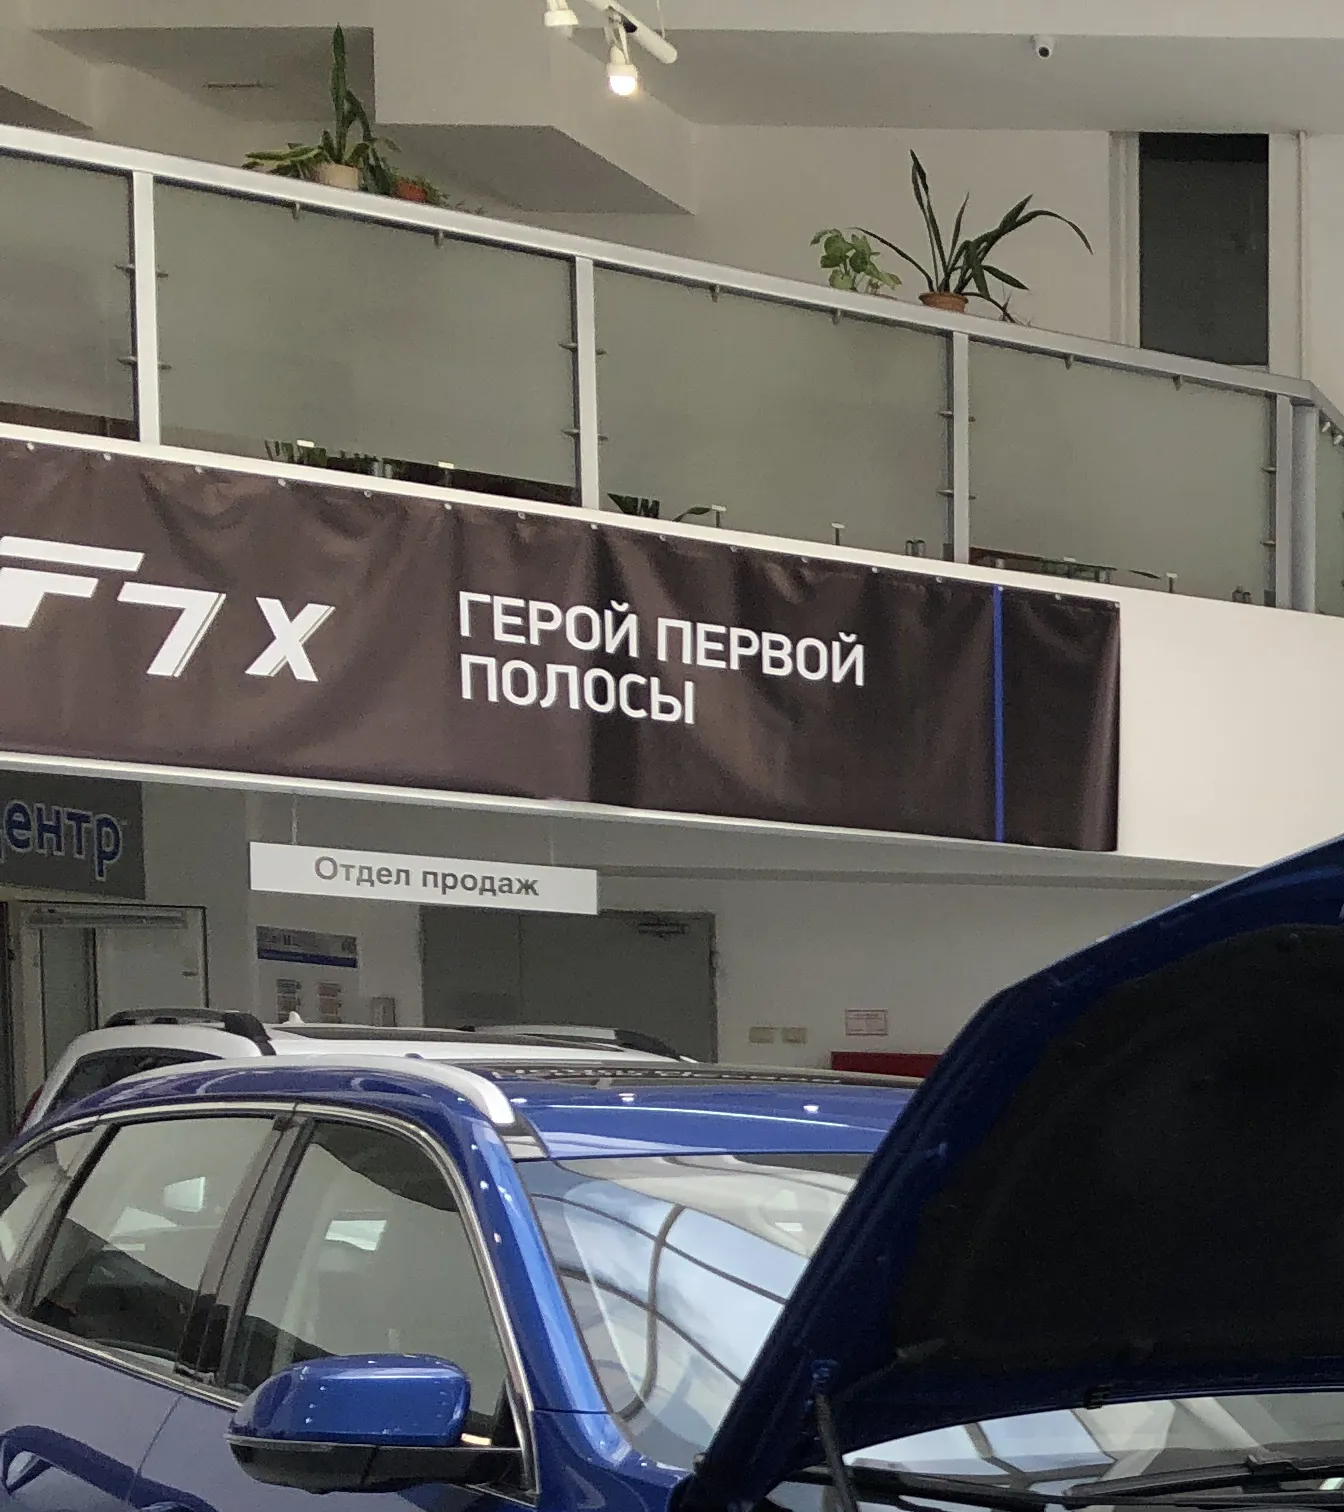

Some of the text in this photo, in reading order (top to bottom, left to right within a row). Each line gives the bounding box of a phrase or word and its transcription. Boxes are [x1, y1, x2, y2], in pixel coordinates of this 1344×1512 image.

[459, 591, 866, 686] ГЕРОЙ ПЕРВОЙ
[460, 654, 695, 724] ПОЛОСЫ
[0, 799, 122, 882] ентр
[314, 856, 539, 897] Отдел продаж
